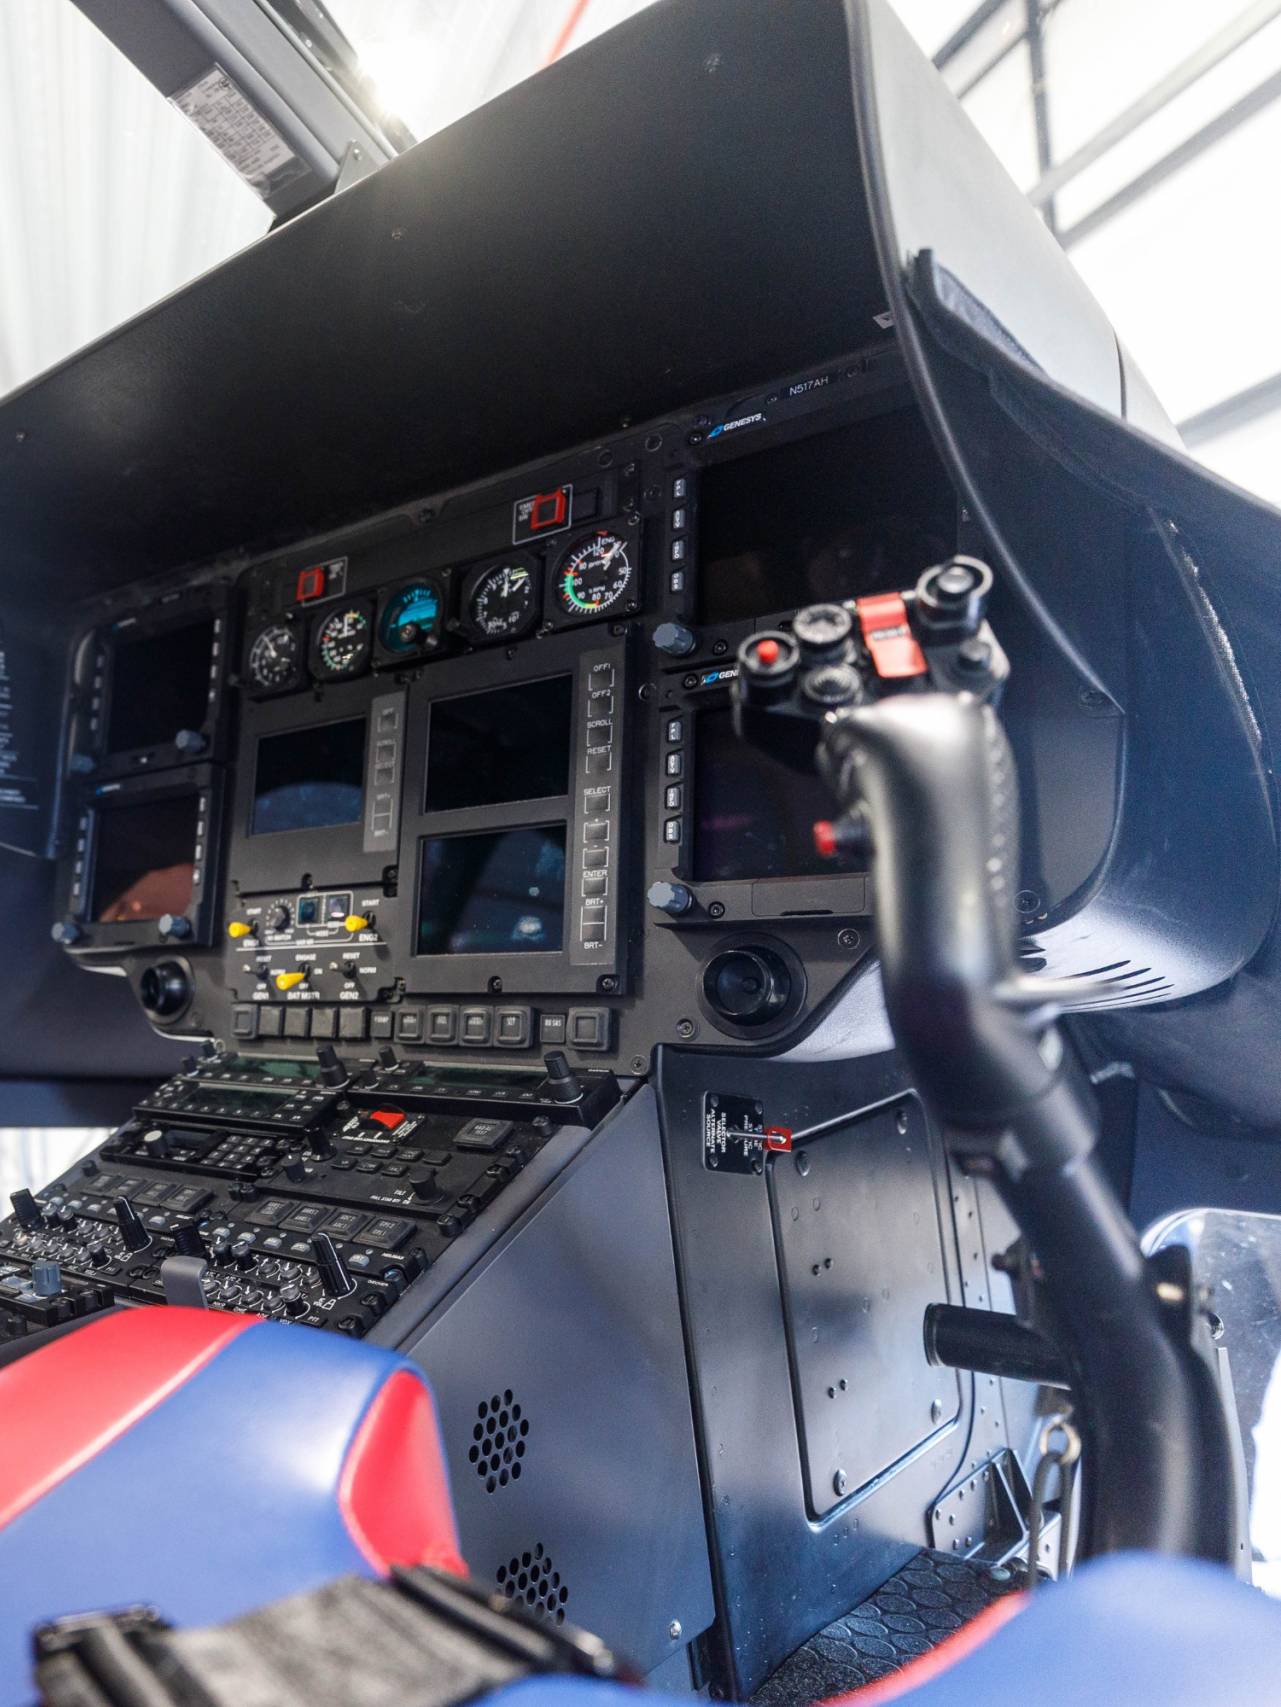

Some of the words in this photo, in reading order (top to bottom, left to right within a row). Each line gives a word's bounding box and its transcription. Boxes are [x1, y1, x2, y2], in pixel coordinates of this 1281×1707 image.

[789, 376, 829, 396] N517AH
[723, 413, 762, 431] GENESYS
[613, 580, 623, 589] 60
[604, 591, 613, 599] 70
[593, 663, 611, 672] OFF1
[591, 689, 611, 699] OFF2
[586, 719, 613, 729] SCROLL
[587, 745, 612, 754] RESET
[584, 785, 611, 796] SELECT
[583, 869, 608, 878] ENTER
[361, 899, 380, 907] START
[585, 898, 604, 906] BRT+
[359, 933, 378, 942] ENG2
[584, 942, 603, 950] BRT-
[342, 952, 360, 960] RESET
[252, 992, 270, 1000] GEN1
[287, 991, 300, 1000] BAT
[301, 991, 320, 1000] MSTR
[339, 991, 360, 1000] GEN2
